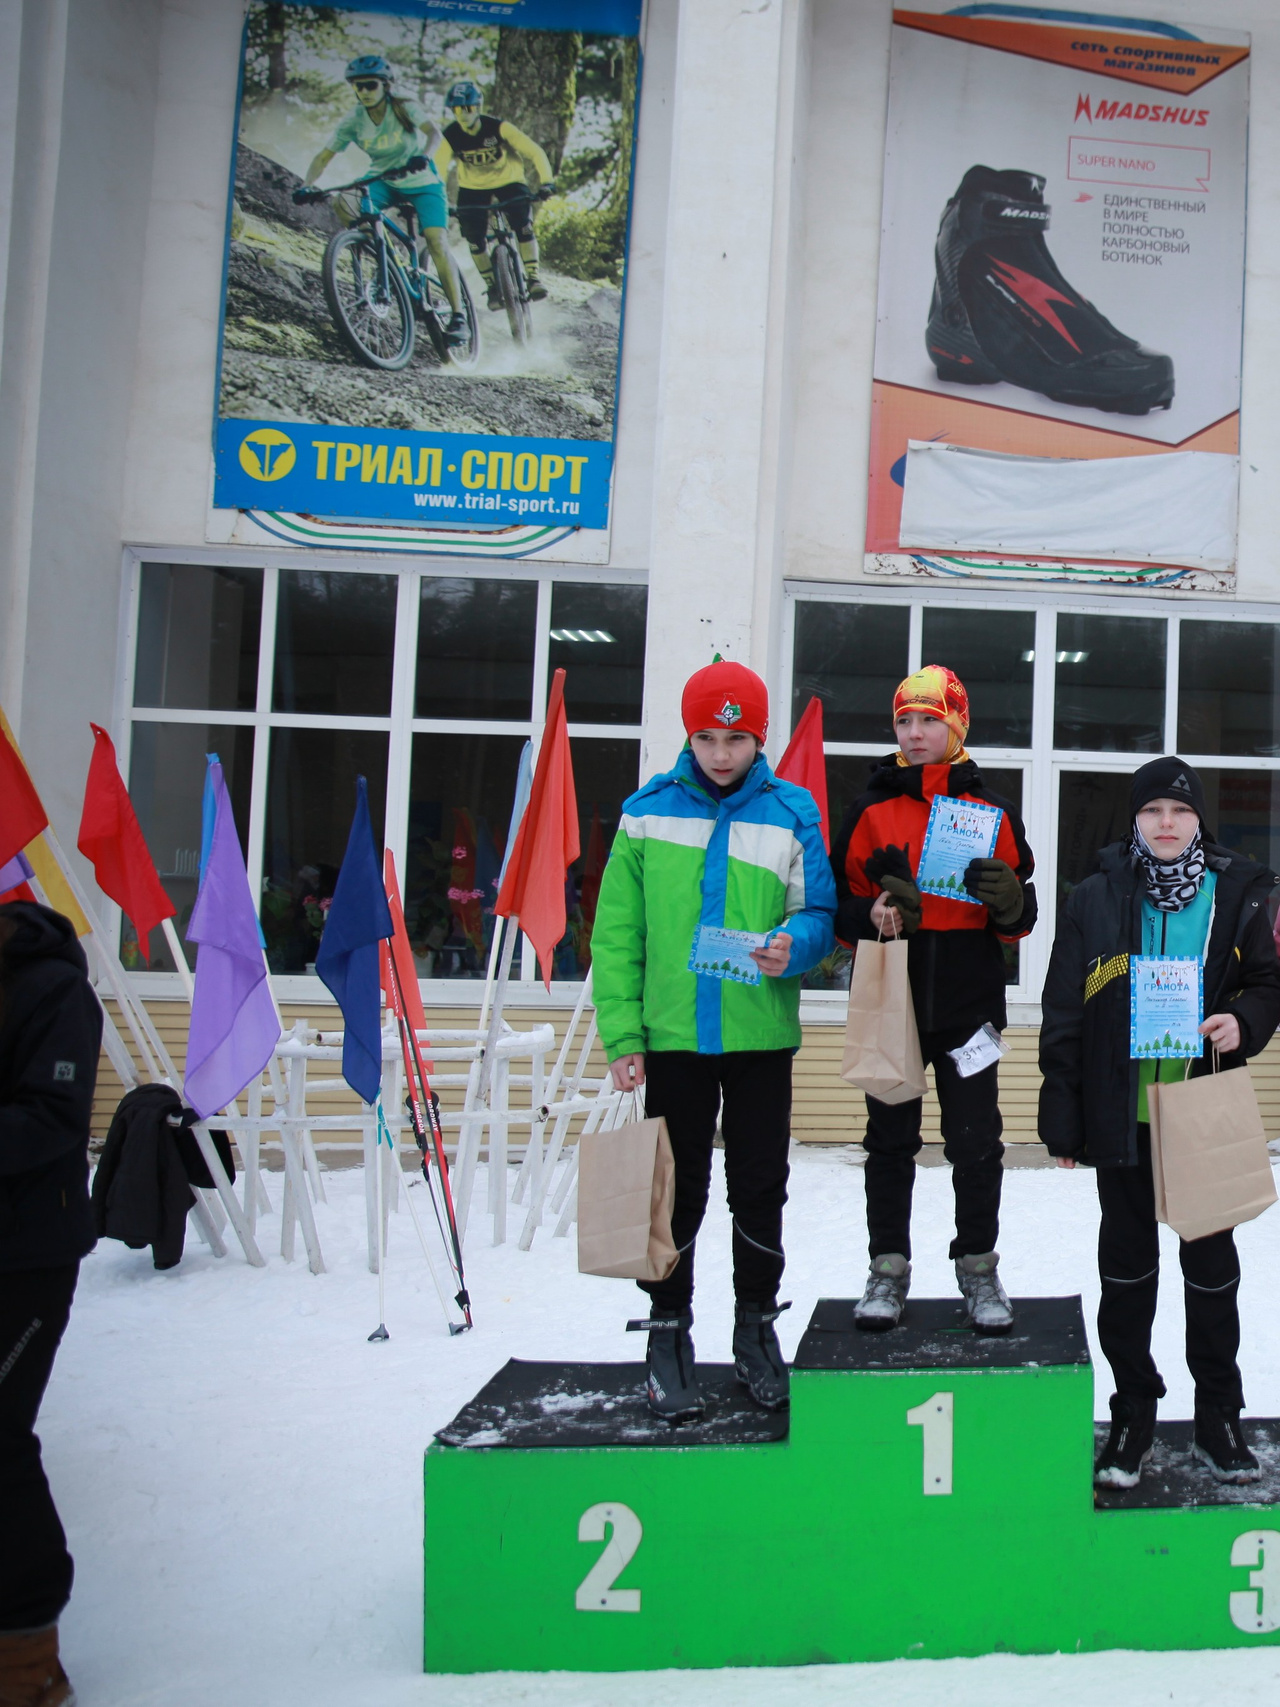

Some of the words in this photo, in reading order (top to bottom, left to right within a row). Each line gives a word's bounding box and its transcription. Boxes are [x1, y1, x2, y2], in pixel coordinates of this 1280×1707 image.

[426, 0, 515, 15] BICYCLES
[1071, 40, 1108, 53] сеть
[1113, 44, 1220, 66] спортивных
[1103, 58, 1196, 76] магазинов
[1095, 99, 1210, 126] MADSHUS
[1077, 154, 1115, 168] SUPER
[1118, 158, 1156, 172] NANO
[1103, 194, 1206, 214] ЕДИНСТВЕННЫЙ
[1103, 209, 1111, 220] В
[1114, 210, 1149, 222] МИРЕ
[1102, 222, 1185, 240] ПОЛНОСТЬЮ
[1102, 236, 1191, 254] КАРБОНОВЫЙ
[1101, 251, 1163, 266] БОТИНОК
[413, 491, 580, 516] www.trial-sport.ru
[940, 823, 984, 841] ГРАМОТА
[1144, 982, 1190, 991] ГРАМОТА
[640, 1319, 679, 1329] SPINE
[906, 1392, 954, 1496] 1
[575, 1501, 644, 1614] 2
